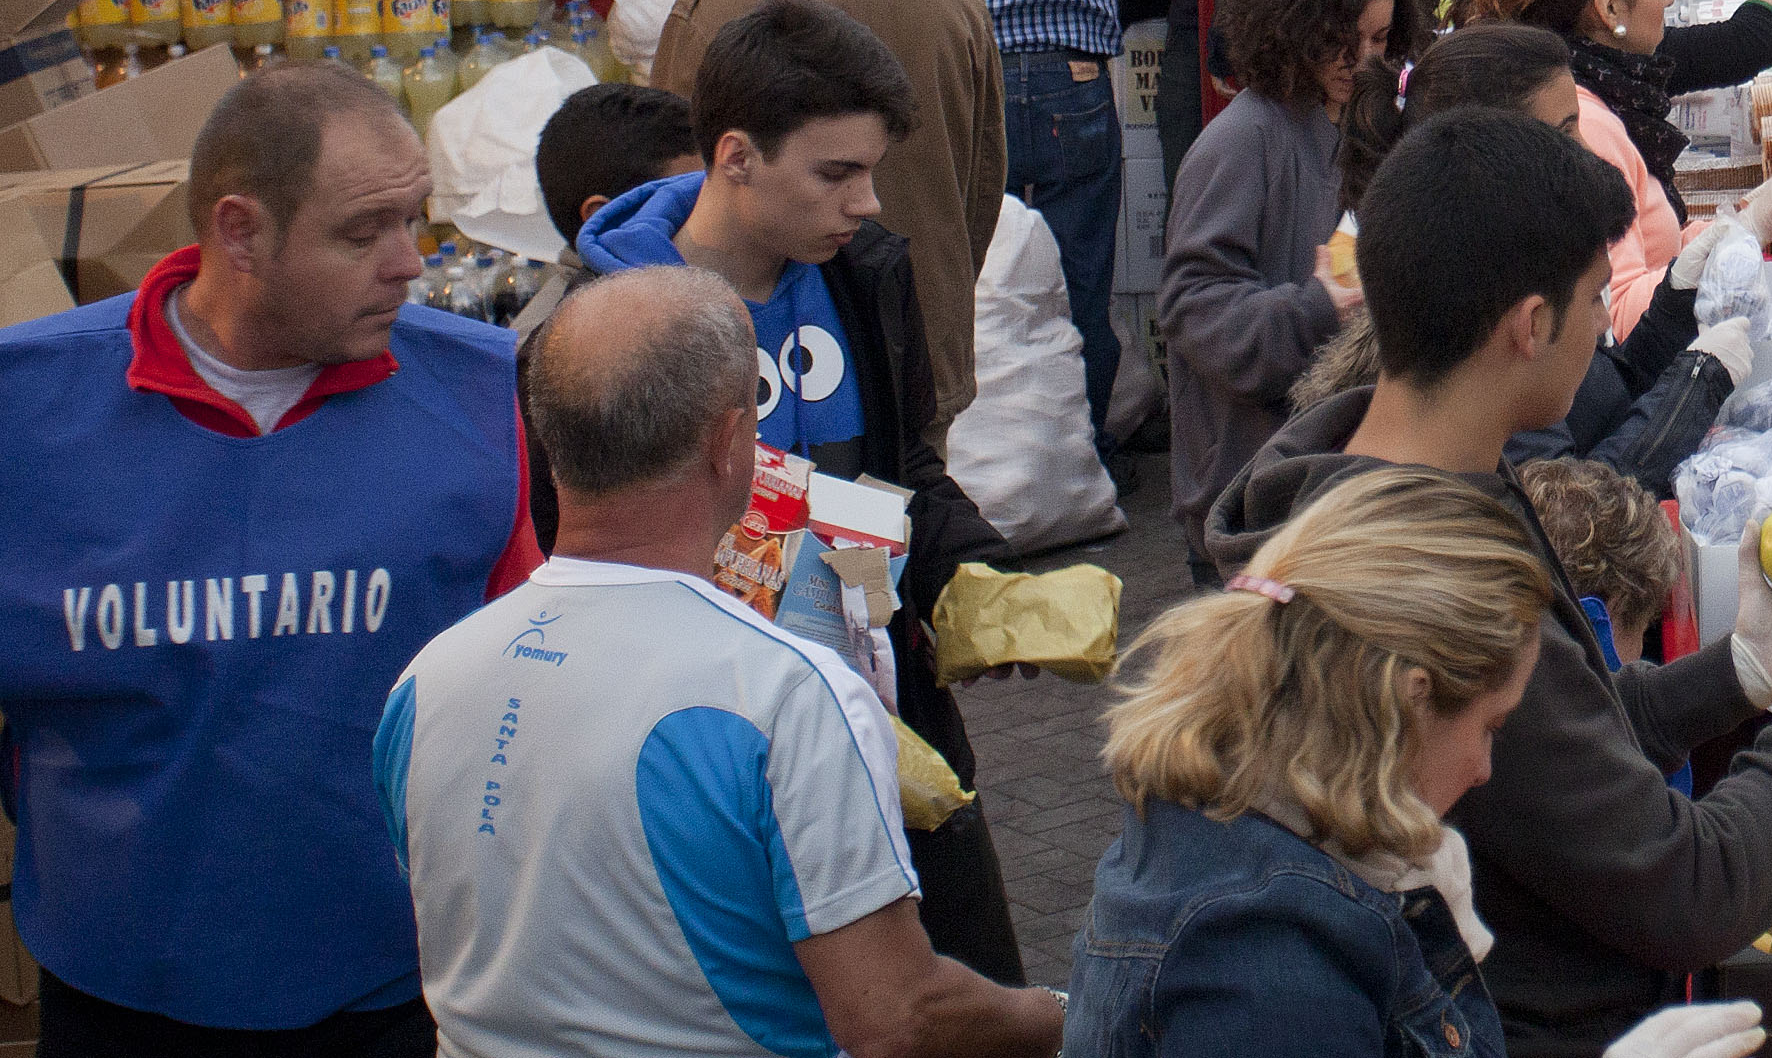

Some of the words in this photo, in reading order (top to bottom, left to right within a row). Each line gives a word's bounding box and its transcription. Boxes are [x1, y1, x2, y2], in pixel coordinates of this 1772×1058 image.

[63, 568, 393, 652] VOLUNTARIO
[491, 697, 522, 766] SANTA
[478, 780, 501, 836] POLA
